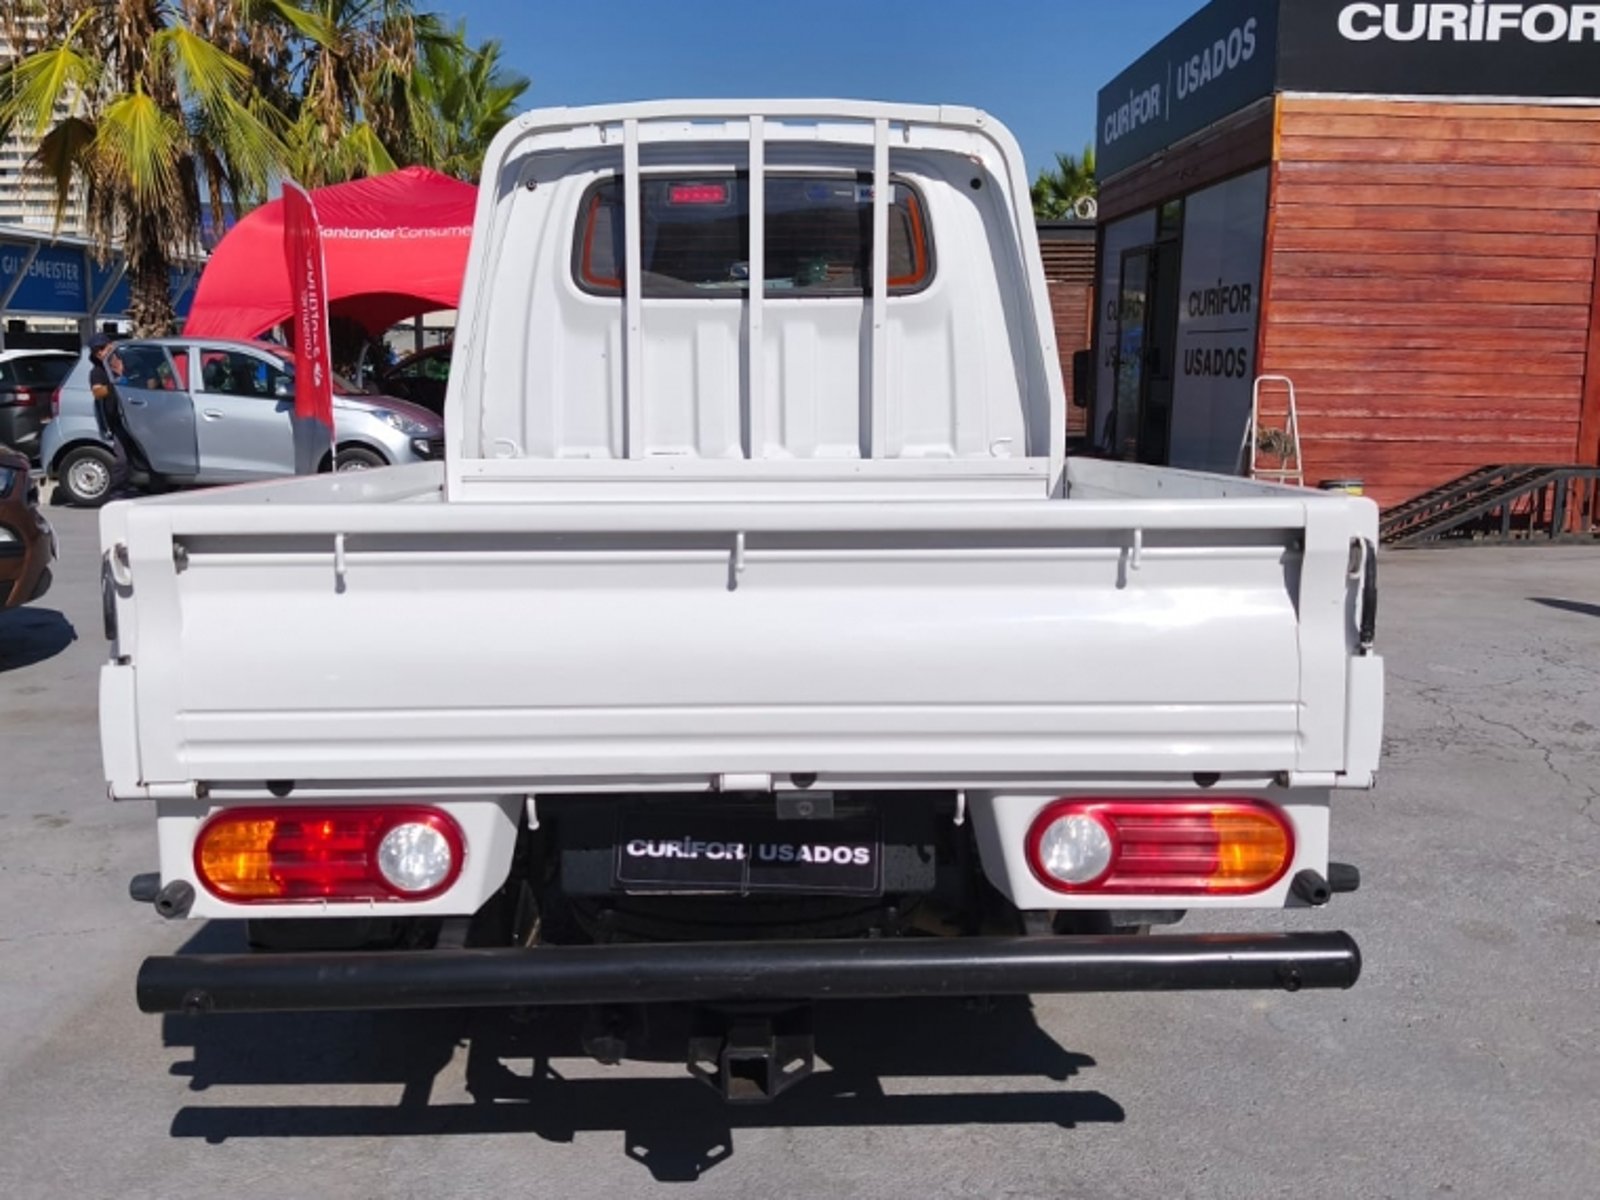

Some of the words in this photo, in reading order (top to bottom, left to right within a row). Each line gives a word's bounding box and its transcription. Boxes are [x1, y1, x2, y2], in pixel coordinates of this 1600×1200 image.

[1176, 16, 1257, 99] USADOS
[399, 224, 473, 238] Consume
[2, 256, 79, 281] GILEMEISTER
[1184, 347, 1247, 378] USADOS
[758, 844, 870, 865] USADOS
